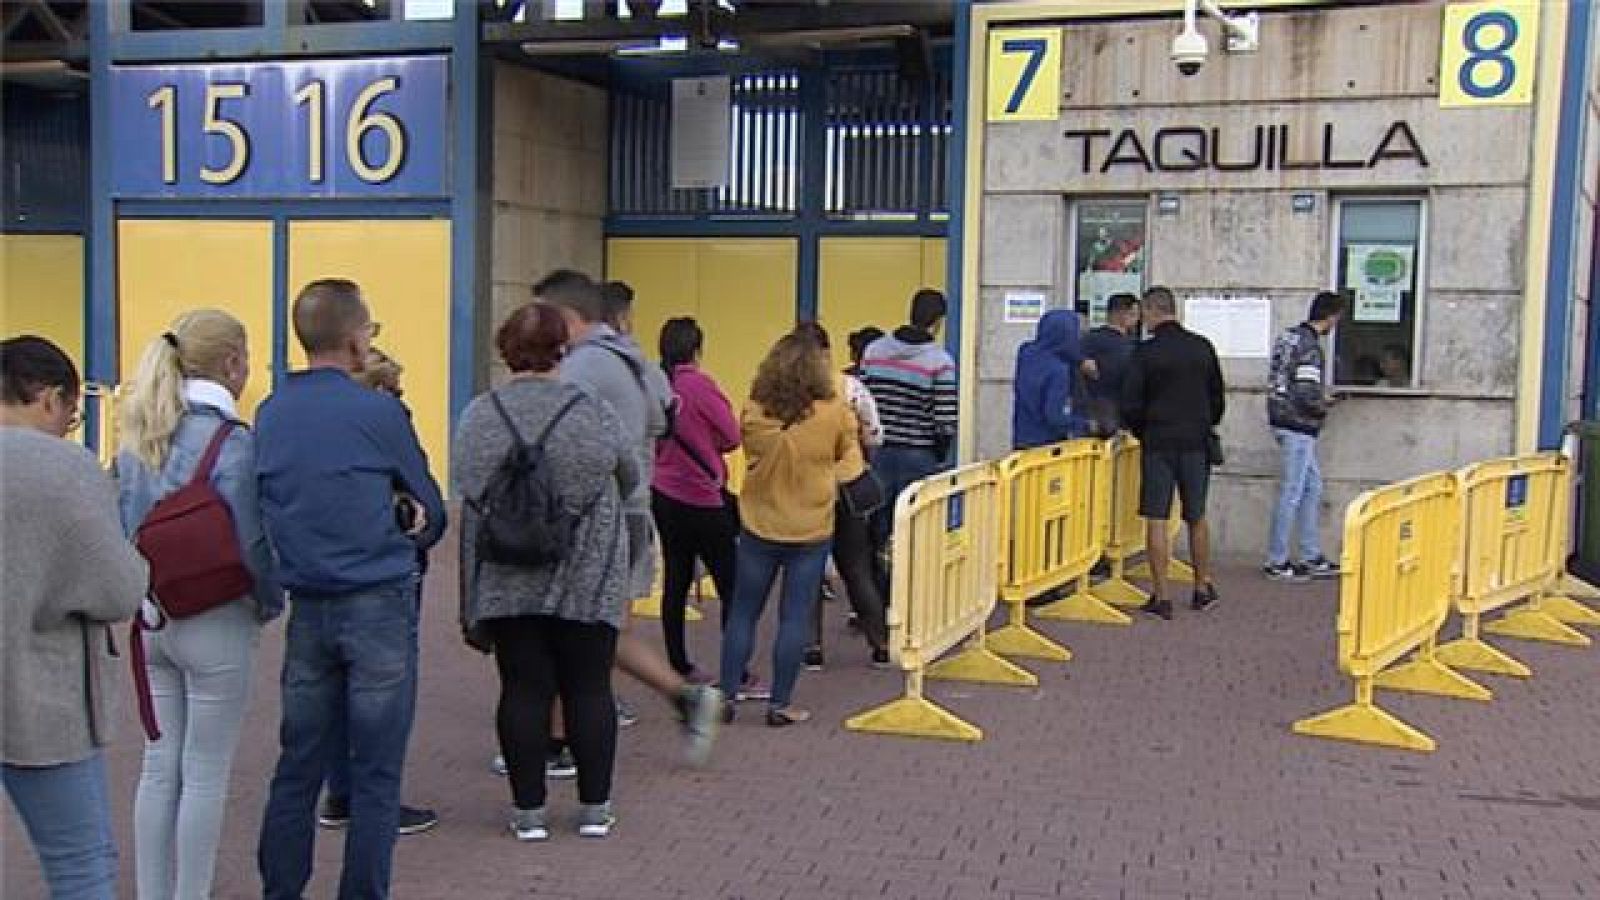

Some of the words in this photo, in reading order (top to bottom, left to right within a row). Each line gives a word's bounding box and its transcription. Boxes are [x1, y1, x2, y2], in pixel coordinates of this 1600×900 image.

[1002, 39, 1048, 114] 7
[1457, 11, 1518, 98] 8
[148, 84, 250, 184] 15
[294, 76, 408, 184] 16
[1064, 120, 1429, 173] TAQUILLA
